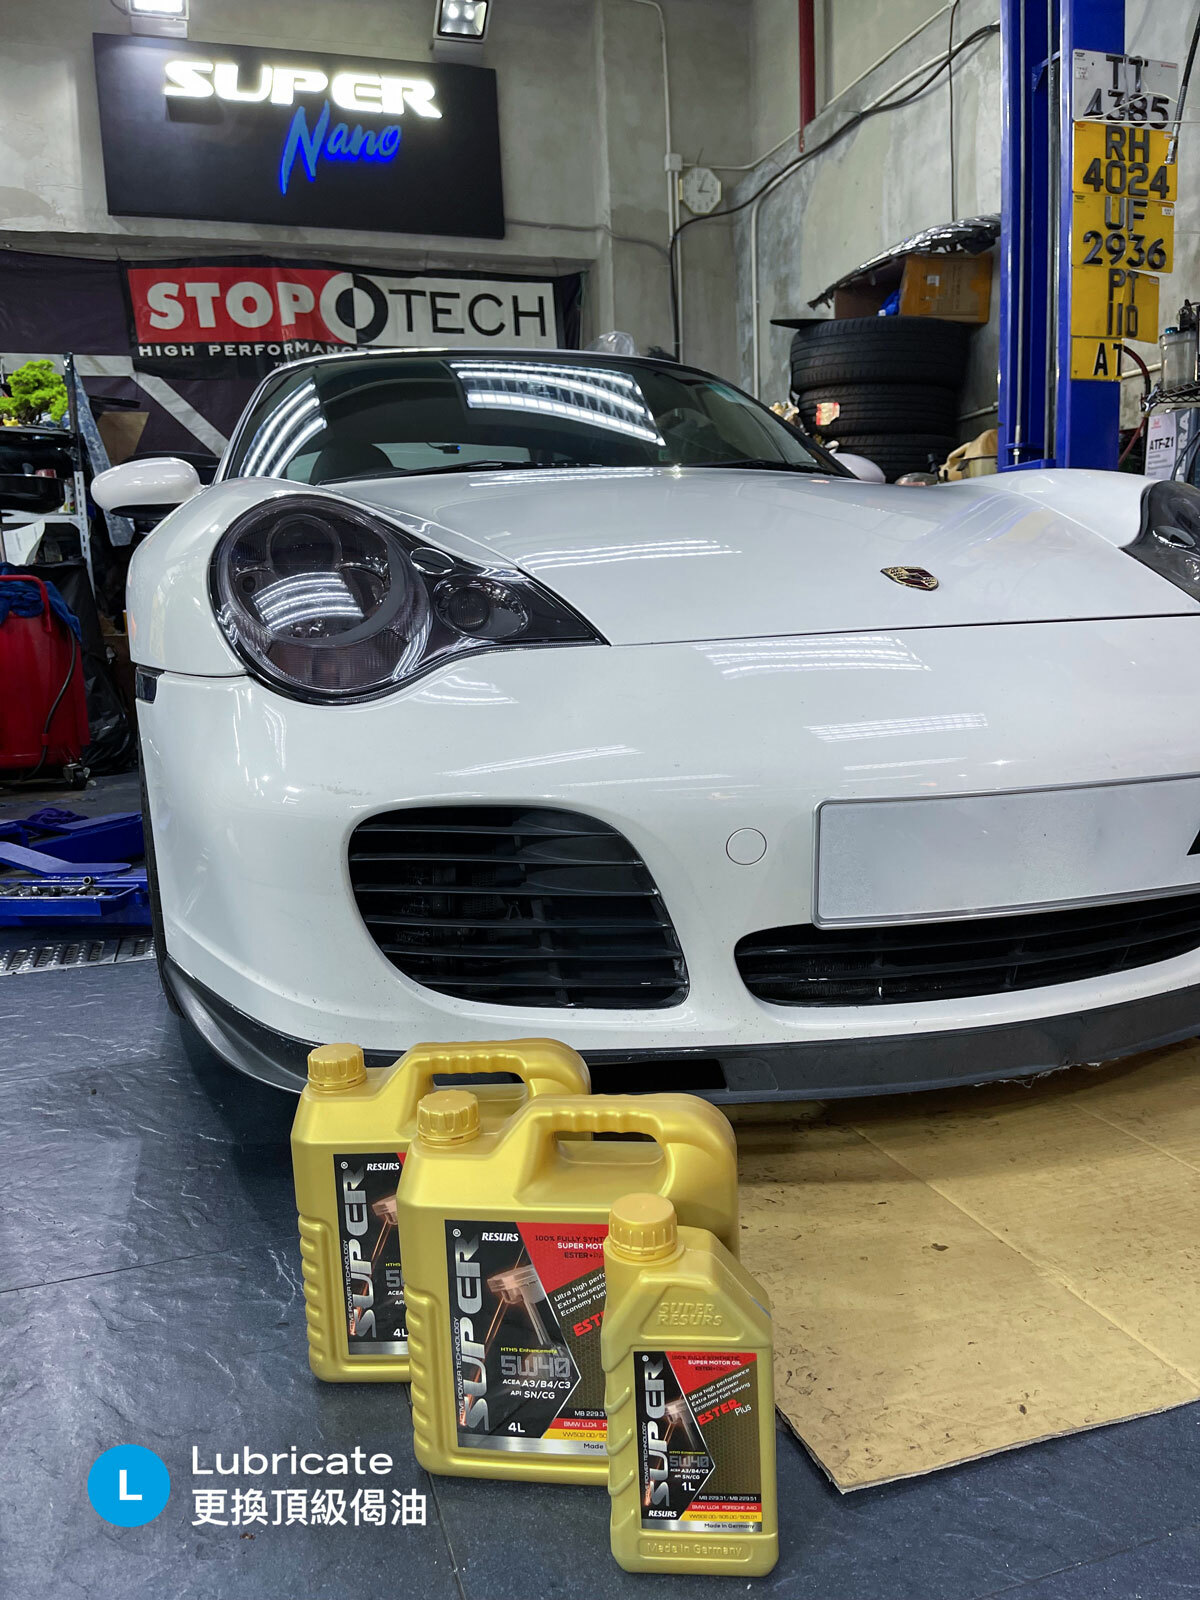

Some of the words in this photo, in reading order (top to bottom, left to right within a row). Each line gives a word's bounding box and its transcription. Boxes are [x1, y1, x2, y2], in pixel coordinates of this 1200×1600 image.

[163, 60, 442, 118] SUPER
[1083, 88, 1169, 130] 4385
[280, 99, 402, 195] Nano
[1105, 125, 1150, 163] RH
[1083, 158, 1170, 199] 4024
[1104, 196, 1148, 231] UF
[1083, 231, 1166, 269] 2936
[138, 345, 195, 357] HIGH
[366, 1162, 400, 1171] RESURS
[481, 1232, 519, 1242] RESURS
[343, 1165, 376, 1338] SUPER
[554, 1289, 572, 1302] Ultra
[572, 1281, 587, 1294] high
[557, 1296, 577, 1310] Extra
[577, 1281, 607, 1299] horsepo
[560, 1298, 592, 1317] Economy
[656, 1314, 723, 1326] RESURS
[659, 1302, 715, 1314] SUPER
[393, 1328, 409, 1338] 4L
[454, 1317, 462, 1370] TECHNOLOGY
[455, 1233, 489, 1431] SUPER
[500, 1355, 572, 1378] 5W40
[456, 1370, 464, 1400] POWER
[522, 1380, 571, 1389] A3/B4/C3
[524, 1391, 556, 1399] SN/CG
[688, 1392, 703, 1401] Ultra
[702, 1385, 716, 1394] high
[716, 1368, 750, 1389] performance
[691, 1396, 707, 1407] Extra
[707, 1380, 739, 1398] horsepower
[693, 1397, 719, 1413] Economy
[719, 1391, 731, 1400] fuel
[731, 1382, 751, 1394] saving
[697, 1399, 742, 1426] ESTER
[734, 1404, 752, 1417] Plus
[508, 1422, 526, 1433] 4L
[644, 1360, 670, 1507] SUPER
[670, 1455, 709, 1468] 5W40
[681, 1482, 696, 1491] 1L
[648, 1510, 677, 1518] RESURS
[647, 1542, 678, 1553] Made
[693, 1544, 742, 1556] Germany
